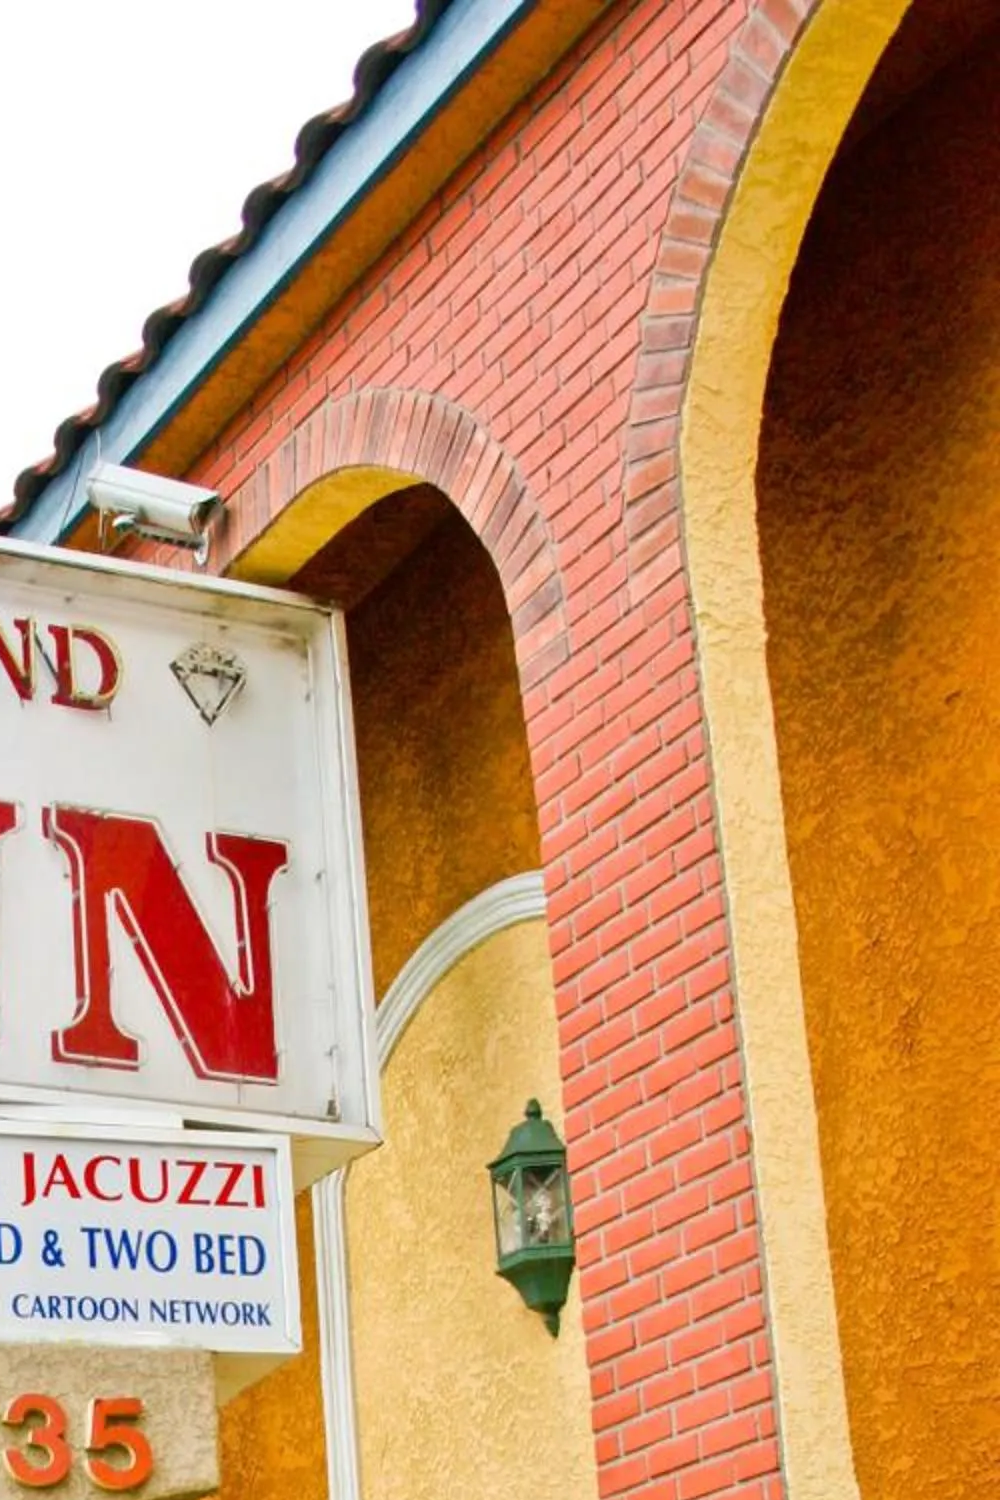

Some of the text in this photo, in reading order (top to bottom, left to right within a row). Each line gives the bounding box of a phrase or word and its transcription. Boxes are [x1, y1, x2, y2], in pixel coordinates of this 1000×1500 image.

[22, 1152, 266, 1209] JACUZZI
[41, 1231, 65, 1268] &
[80, 1228, 177, 1273] TWO
[194, 1233, 267, 1276] BED
[12, 1293, 140, 1323] CARTOON
[149, 1299, 272, 1327] NETWORK
